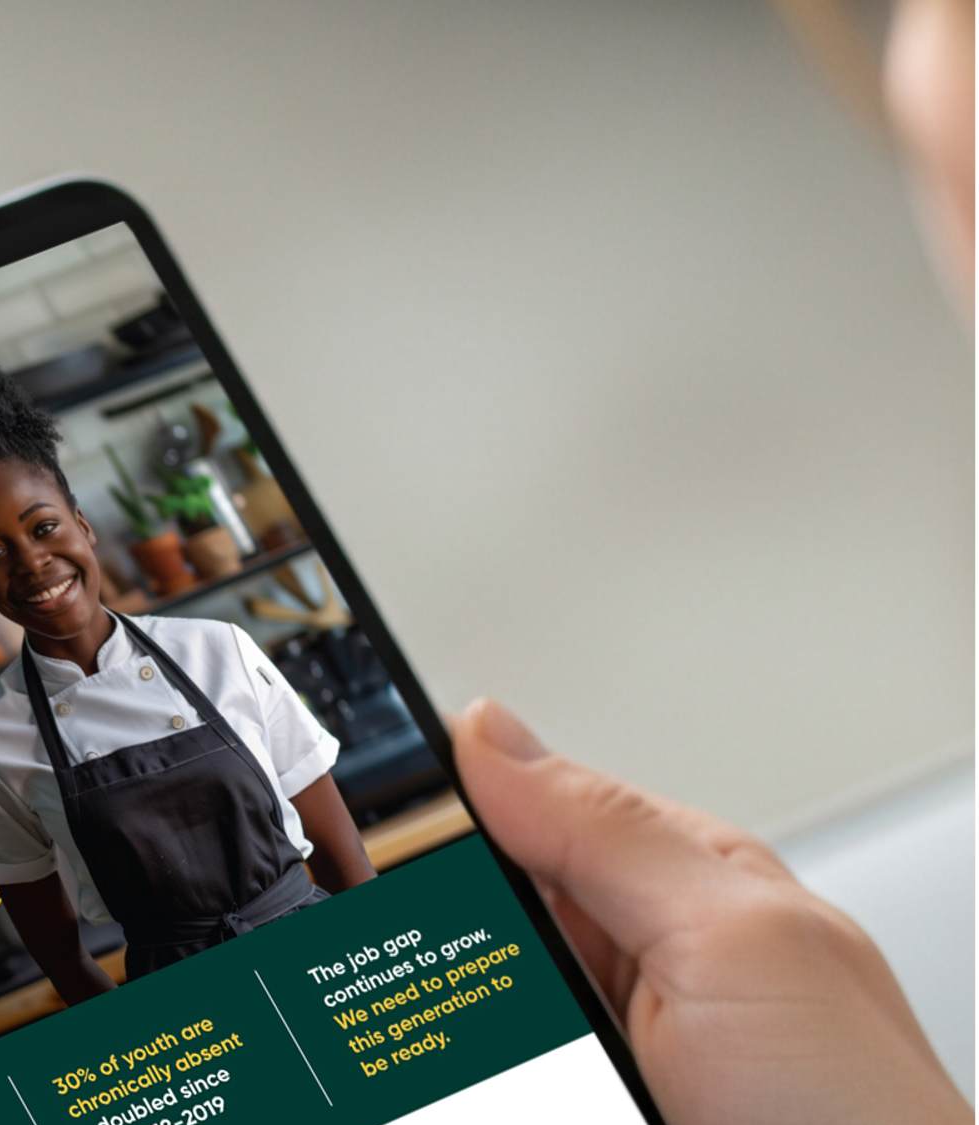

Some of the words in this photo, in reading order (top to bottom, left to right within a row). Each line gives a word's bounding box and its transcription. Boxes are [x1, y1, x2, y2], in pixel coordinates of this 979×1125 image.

[307, 963, 346, 984] The
[346, 946, 380, 973] job
[383, 930, 421, 957] gap
[324, 961, 414, 1007] continues
[415, 951, 437, 967] to
[441, 929, 491, 960] grow.
[333, 1009, 368, 1029] We
[371, 983, 420, 1015] need
[421, 977, 443, 992] to
[445, 944, 520, 987] prepare
[349, 1030, 385, 1053] this
[388, 985, 490, 1040] generation
[491, 976, 512, 991] to
[52, 1068, 96, 1095] 30%
[100, 1054, 119, 1075] of
[121, 1033, 178, 1070] youth
[181, 1019, 213, 1040] are
[69, 1065, 171, 1117] chronically
[175, 1033, 243, 1071] absent
[180, 1069, 230, 1098] since
[360, 1058, 388, 1077] be
[391, 1032, 450, 1064] ready.
